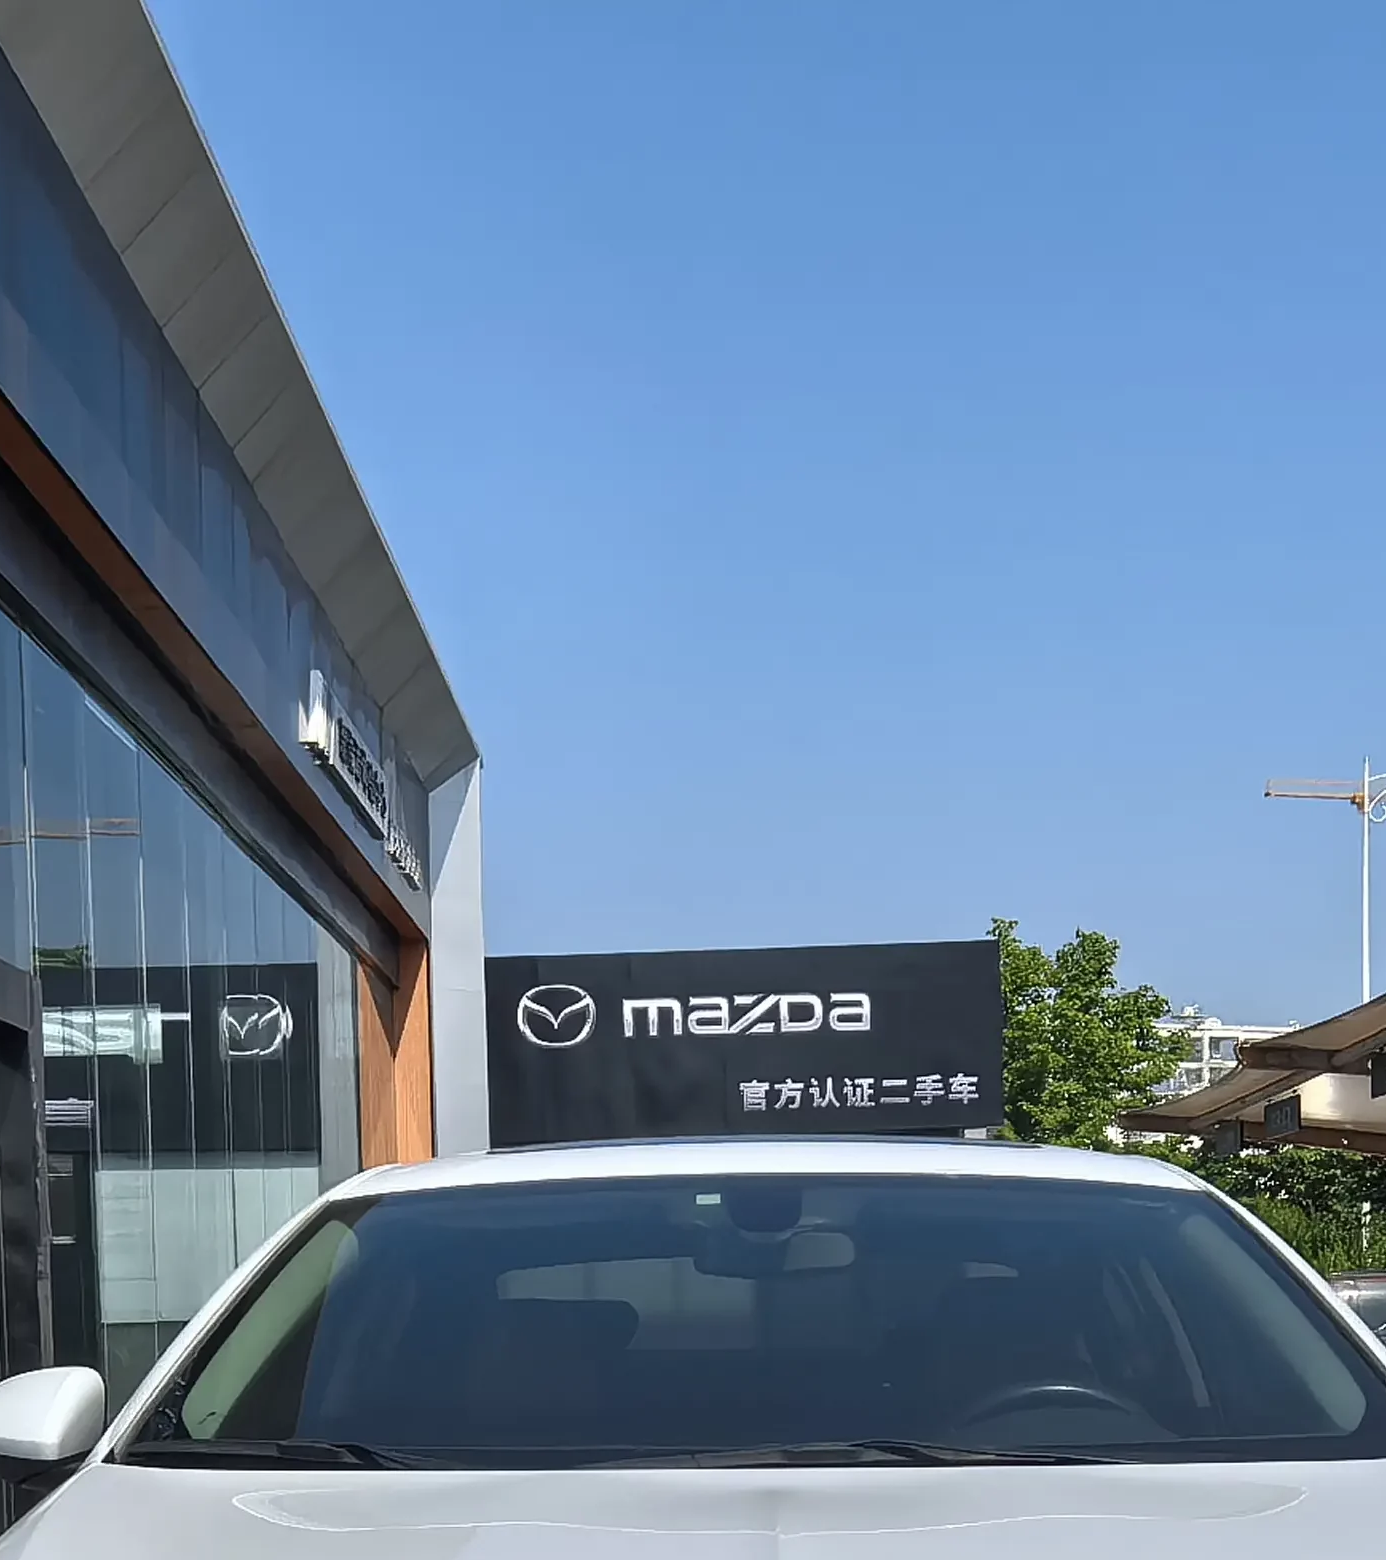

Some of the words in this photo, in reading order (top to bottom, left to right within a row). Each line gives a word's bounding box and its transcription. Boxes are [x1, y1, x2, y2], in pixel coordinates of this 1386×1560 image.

[739, 1072, 979, 1112] 官方认证二手车
